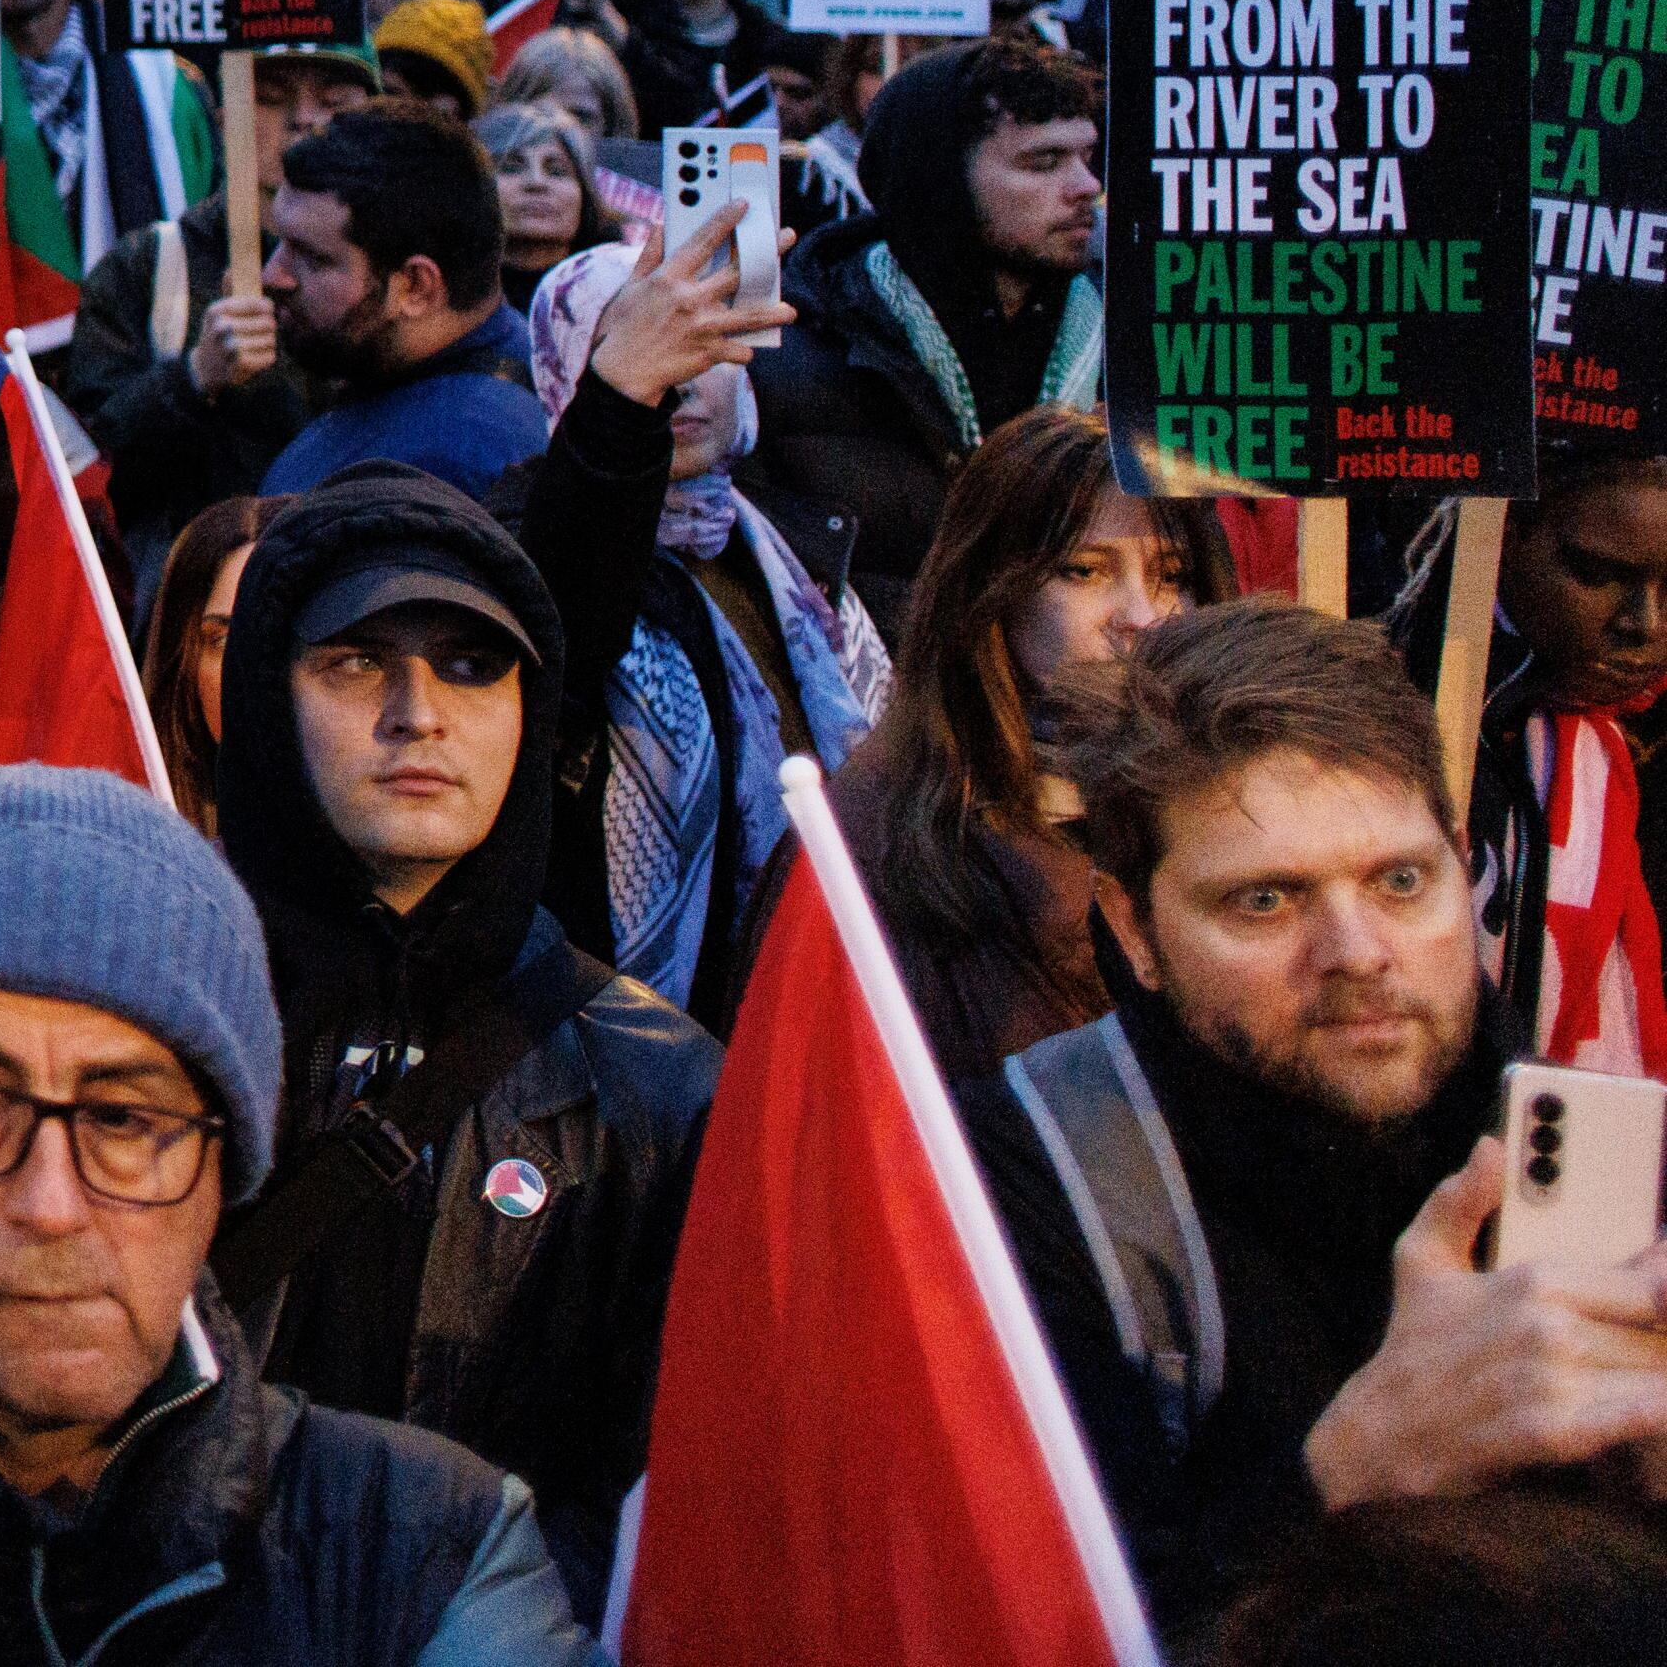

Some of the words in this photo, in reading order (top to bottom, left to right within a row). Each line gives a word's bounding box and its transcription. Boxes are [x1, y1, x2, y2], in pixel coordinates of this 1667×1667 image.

[1154, 75, 1339, 150] RIVER
[1357, 73, 1436, 150] TO
[1563, 50, 1644, 126] TO
[1152, 157, 1273, 232] THE
[1296, 157, 1407, 233] SEA
[1153, 239, 1483, 315] PALESTINE
[1153, 323, 1308, 397] WILL
[1330, 322, 1400, 397] BE
[1573, 353, 1619, 392] the
[1156, 405, 1311, 480] FREE
[1337, 405, 1397, 440] Back
[1405, 405, 1453, 439] the
[1337, 445, 1481, 479] resistance
